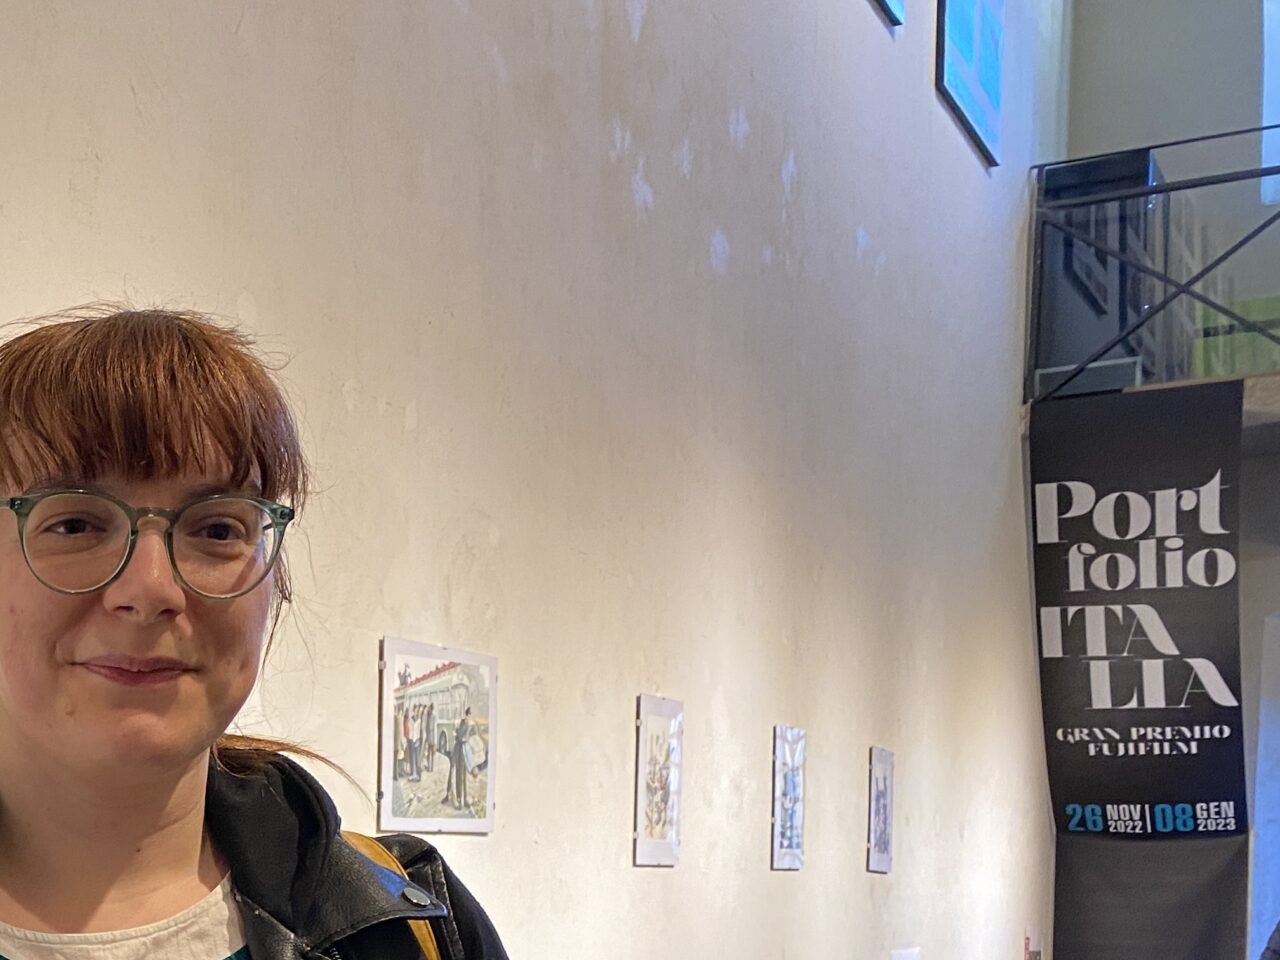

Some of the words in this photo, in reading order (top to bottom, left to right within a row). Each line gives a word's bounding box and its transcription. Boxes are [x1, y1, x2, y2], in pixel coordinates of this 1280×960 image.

[1035, 468, 1231, 544] Port
[1064, 537, 1237, 592] folio
[1040, 604, 1181, 658] ITA
[1081, 657, 1240, 709] LIA
[1056, 727, 1121, 743] GRAN
[1130, 725, 1231, 741] PREMIO
[1088, 741, 1198, 757] FUJIFILM
[1065, 803, 1104, 832] 26
[1106, 804, 1141, 821] NOV
[1153, 803, 1194, 832] 08
[1196, 801, 1235, 819] GEN
[1108, 820, 1144, 833] 2022
[1197, 818, 1236, 832] 2023
